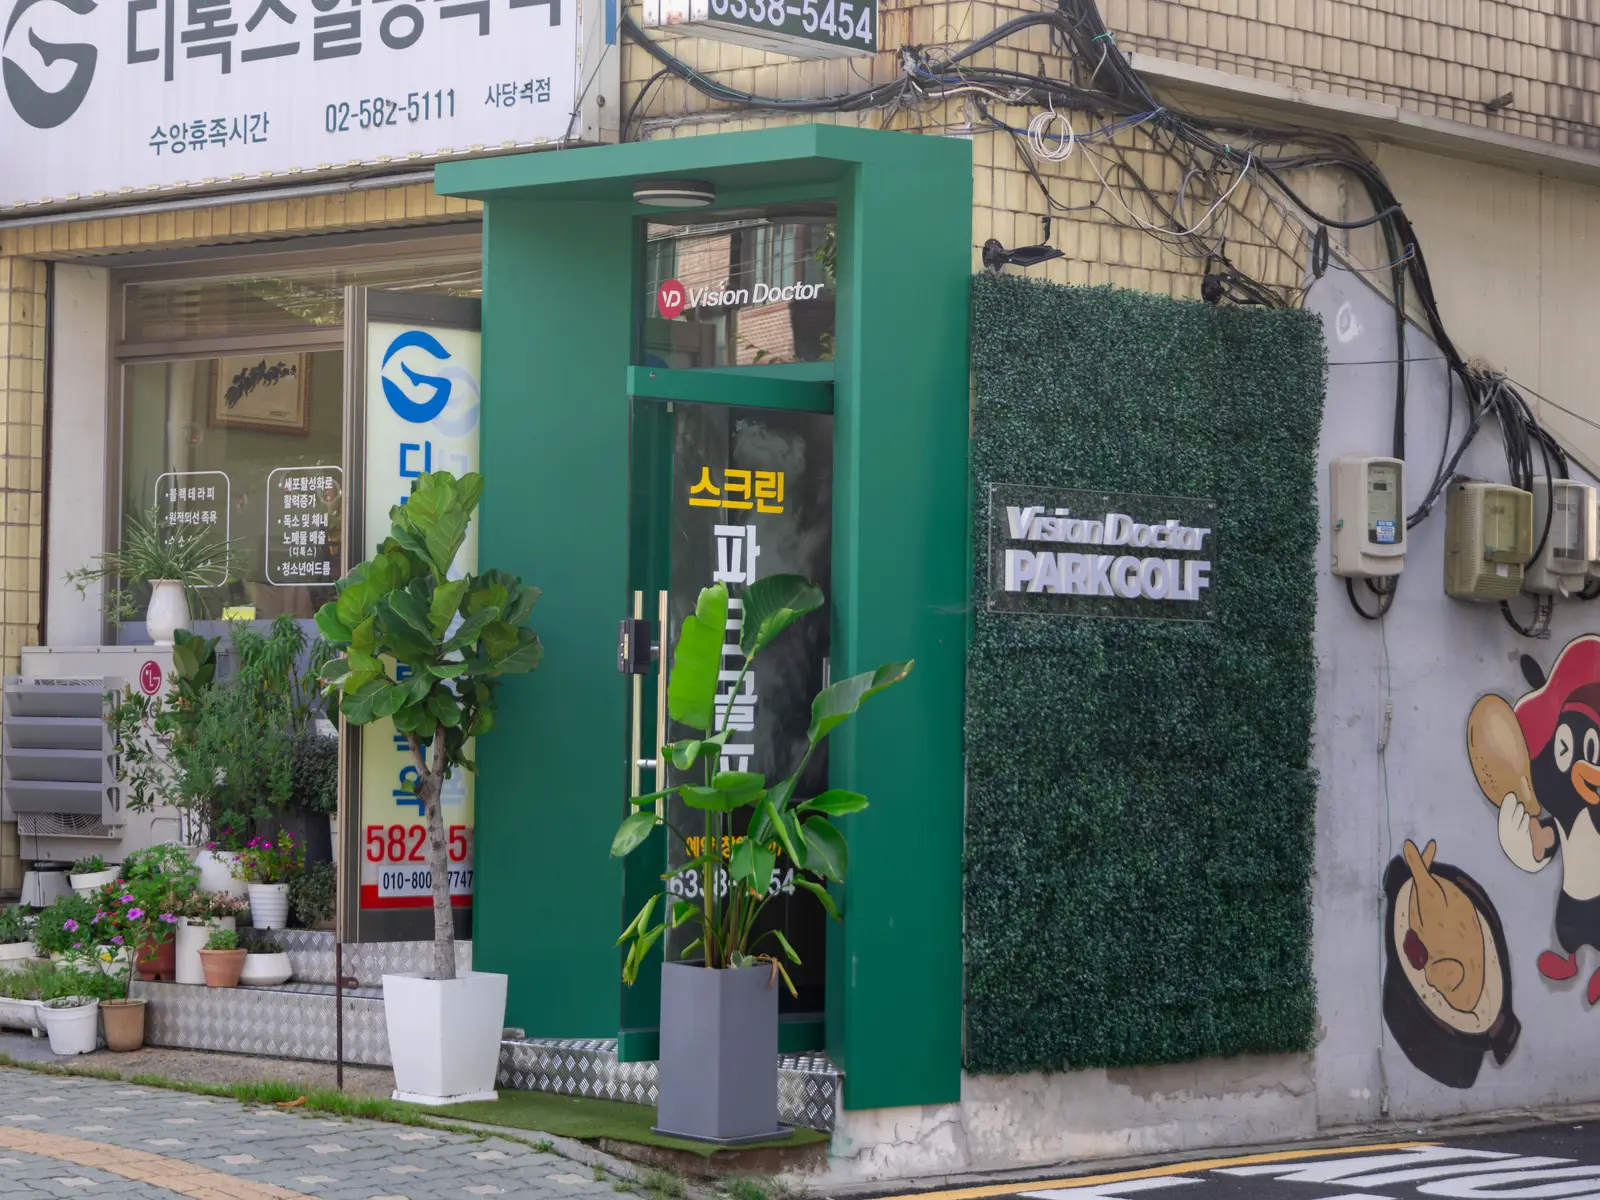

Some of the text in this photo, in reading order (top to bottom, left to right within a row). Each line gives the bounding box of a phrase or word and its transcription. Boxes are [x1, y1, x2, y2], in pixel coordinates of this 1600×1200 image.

[484, 76, 551, 108] 사당역점
[325, 88, 455, 133] 02-582-5111
[148, 111, 270, 156] 수앙휴족시간
[688, 286, 748, 308] Vision
[752, 281, 825, 304] Doctor
[283, 493, 316, 509] 활력증가
[688, 466, 785, 515] 스크린
[283, 514, 300, 528] 독소
[281, 561, 331, 577] 청소년여드름
[1005, 549, 1212, 601] PARKGOLF
